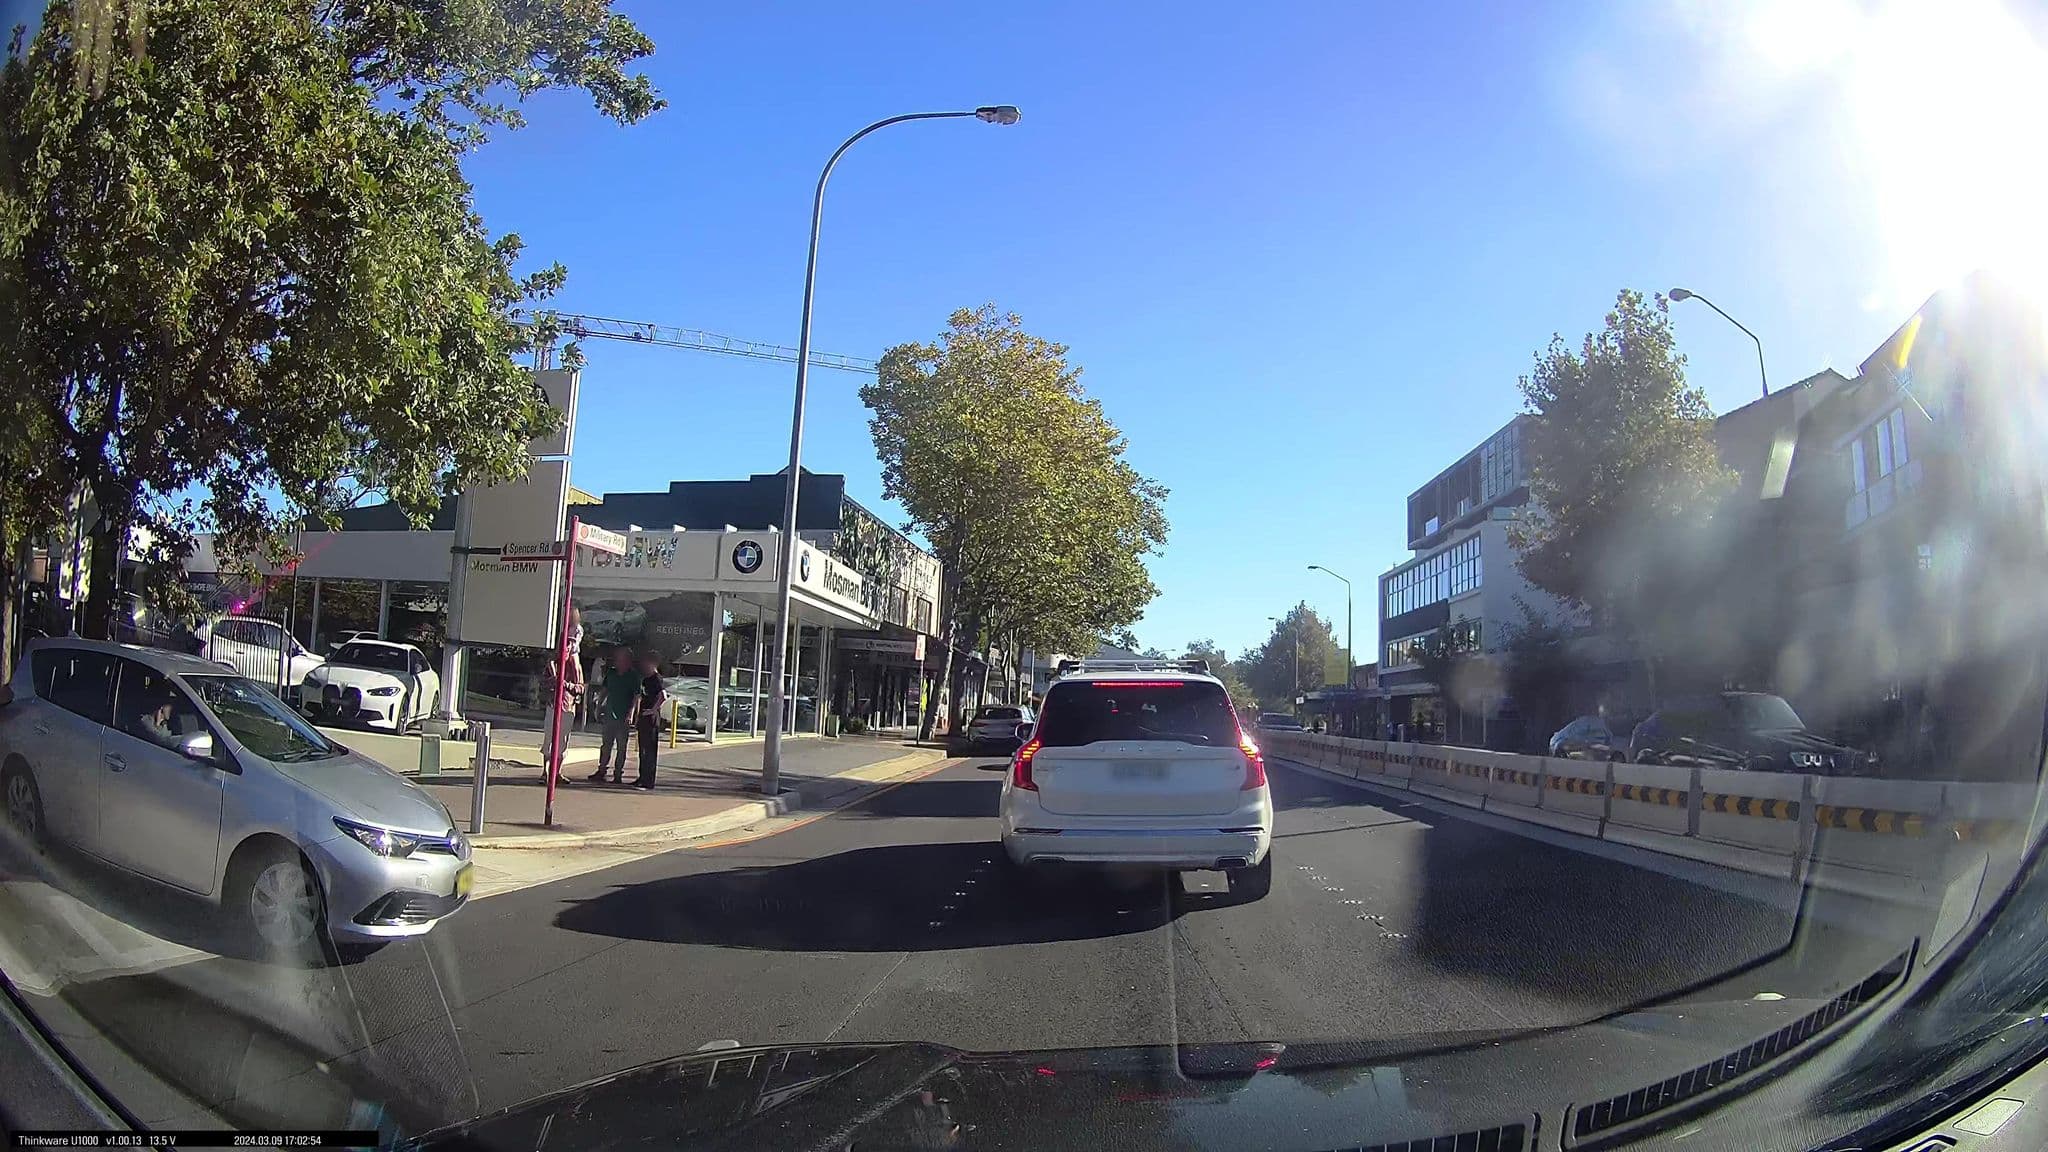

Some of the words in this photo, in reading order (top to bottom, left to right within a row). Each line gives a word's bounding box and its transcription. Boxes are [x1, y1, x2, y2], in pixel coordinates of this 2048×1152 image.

[590, 527, 612, 545] Military
[508, 542, 538, 555] Spencer
[512, 561, 539, 573] BMW
[823, 559, 861, 603] Mosman
